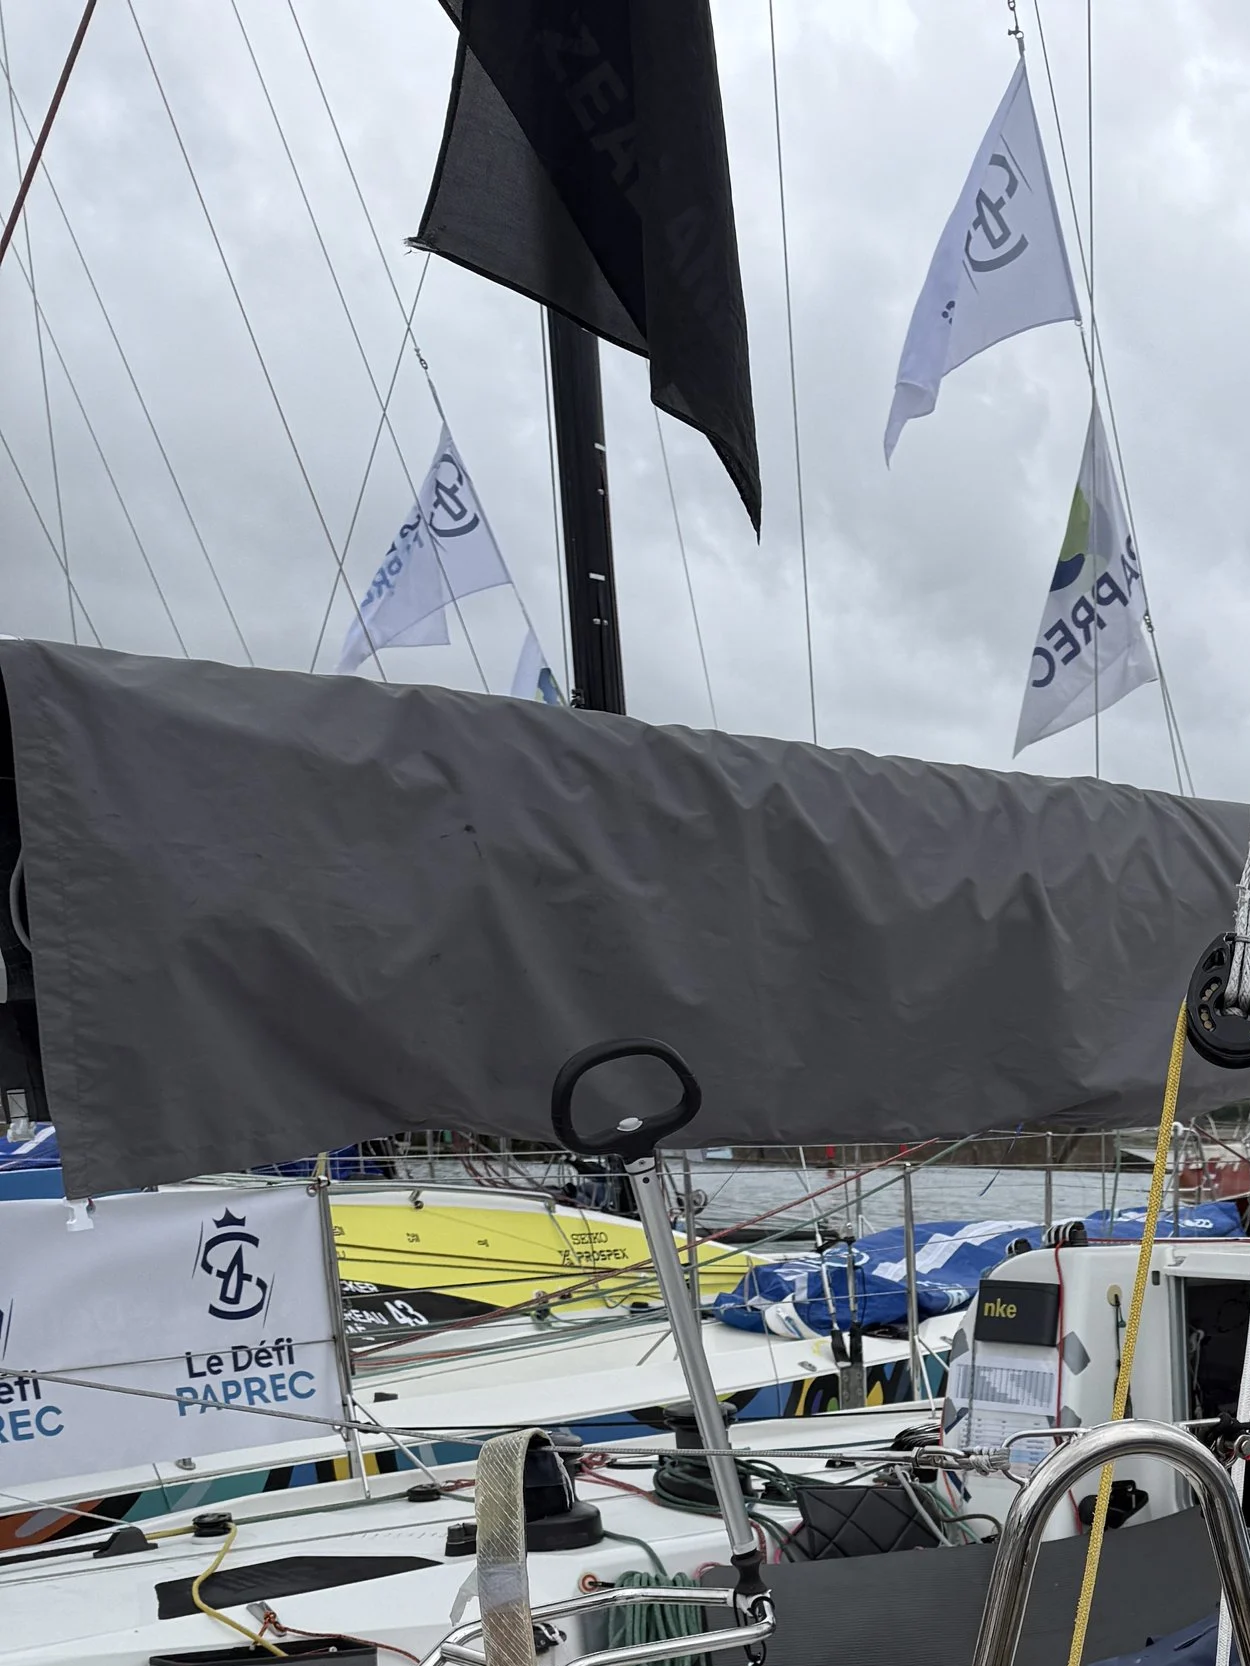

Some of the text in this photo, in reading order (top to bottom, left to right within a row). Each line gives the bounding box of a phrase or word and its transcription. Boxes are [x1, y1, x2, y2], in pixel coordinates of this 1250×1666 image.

[571, 1232, 609, 1246] SEIKO
[576, 1248, 629, 1262] PROSPEX
[384, 1299, 430, 1328] 43
[984, 1298, 1017, 1319] nke
[185, 1337, 296, 1379] Le Défi
[175, 1370, 316, 1417] PAPREC
